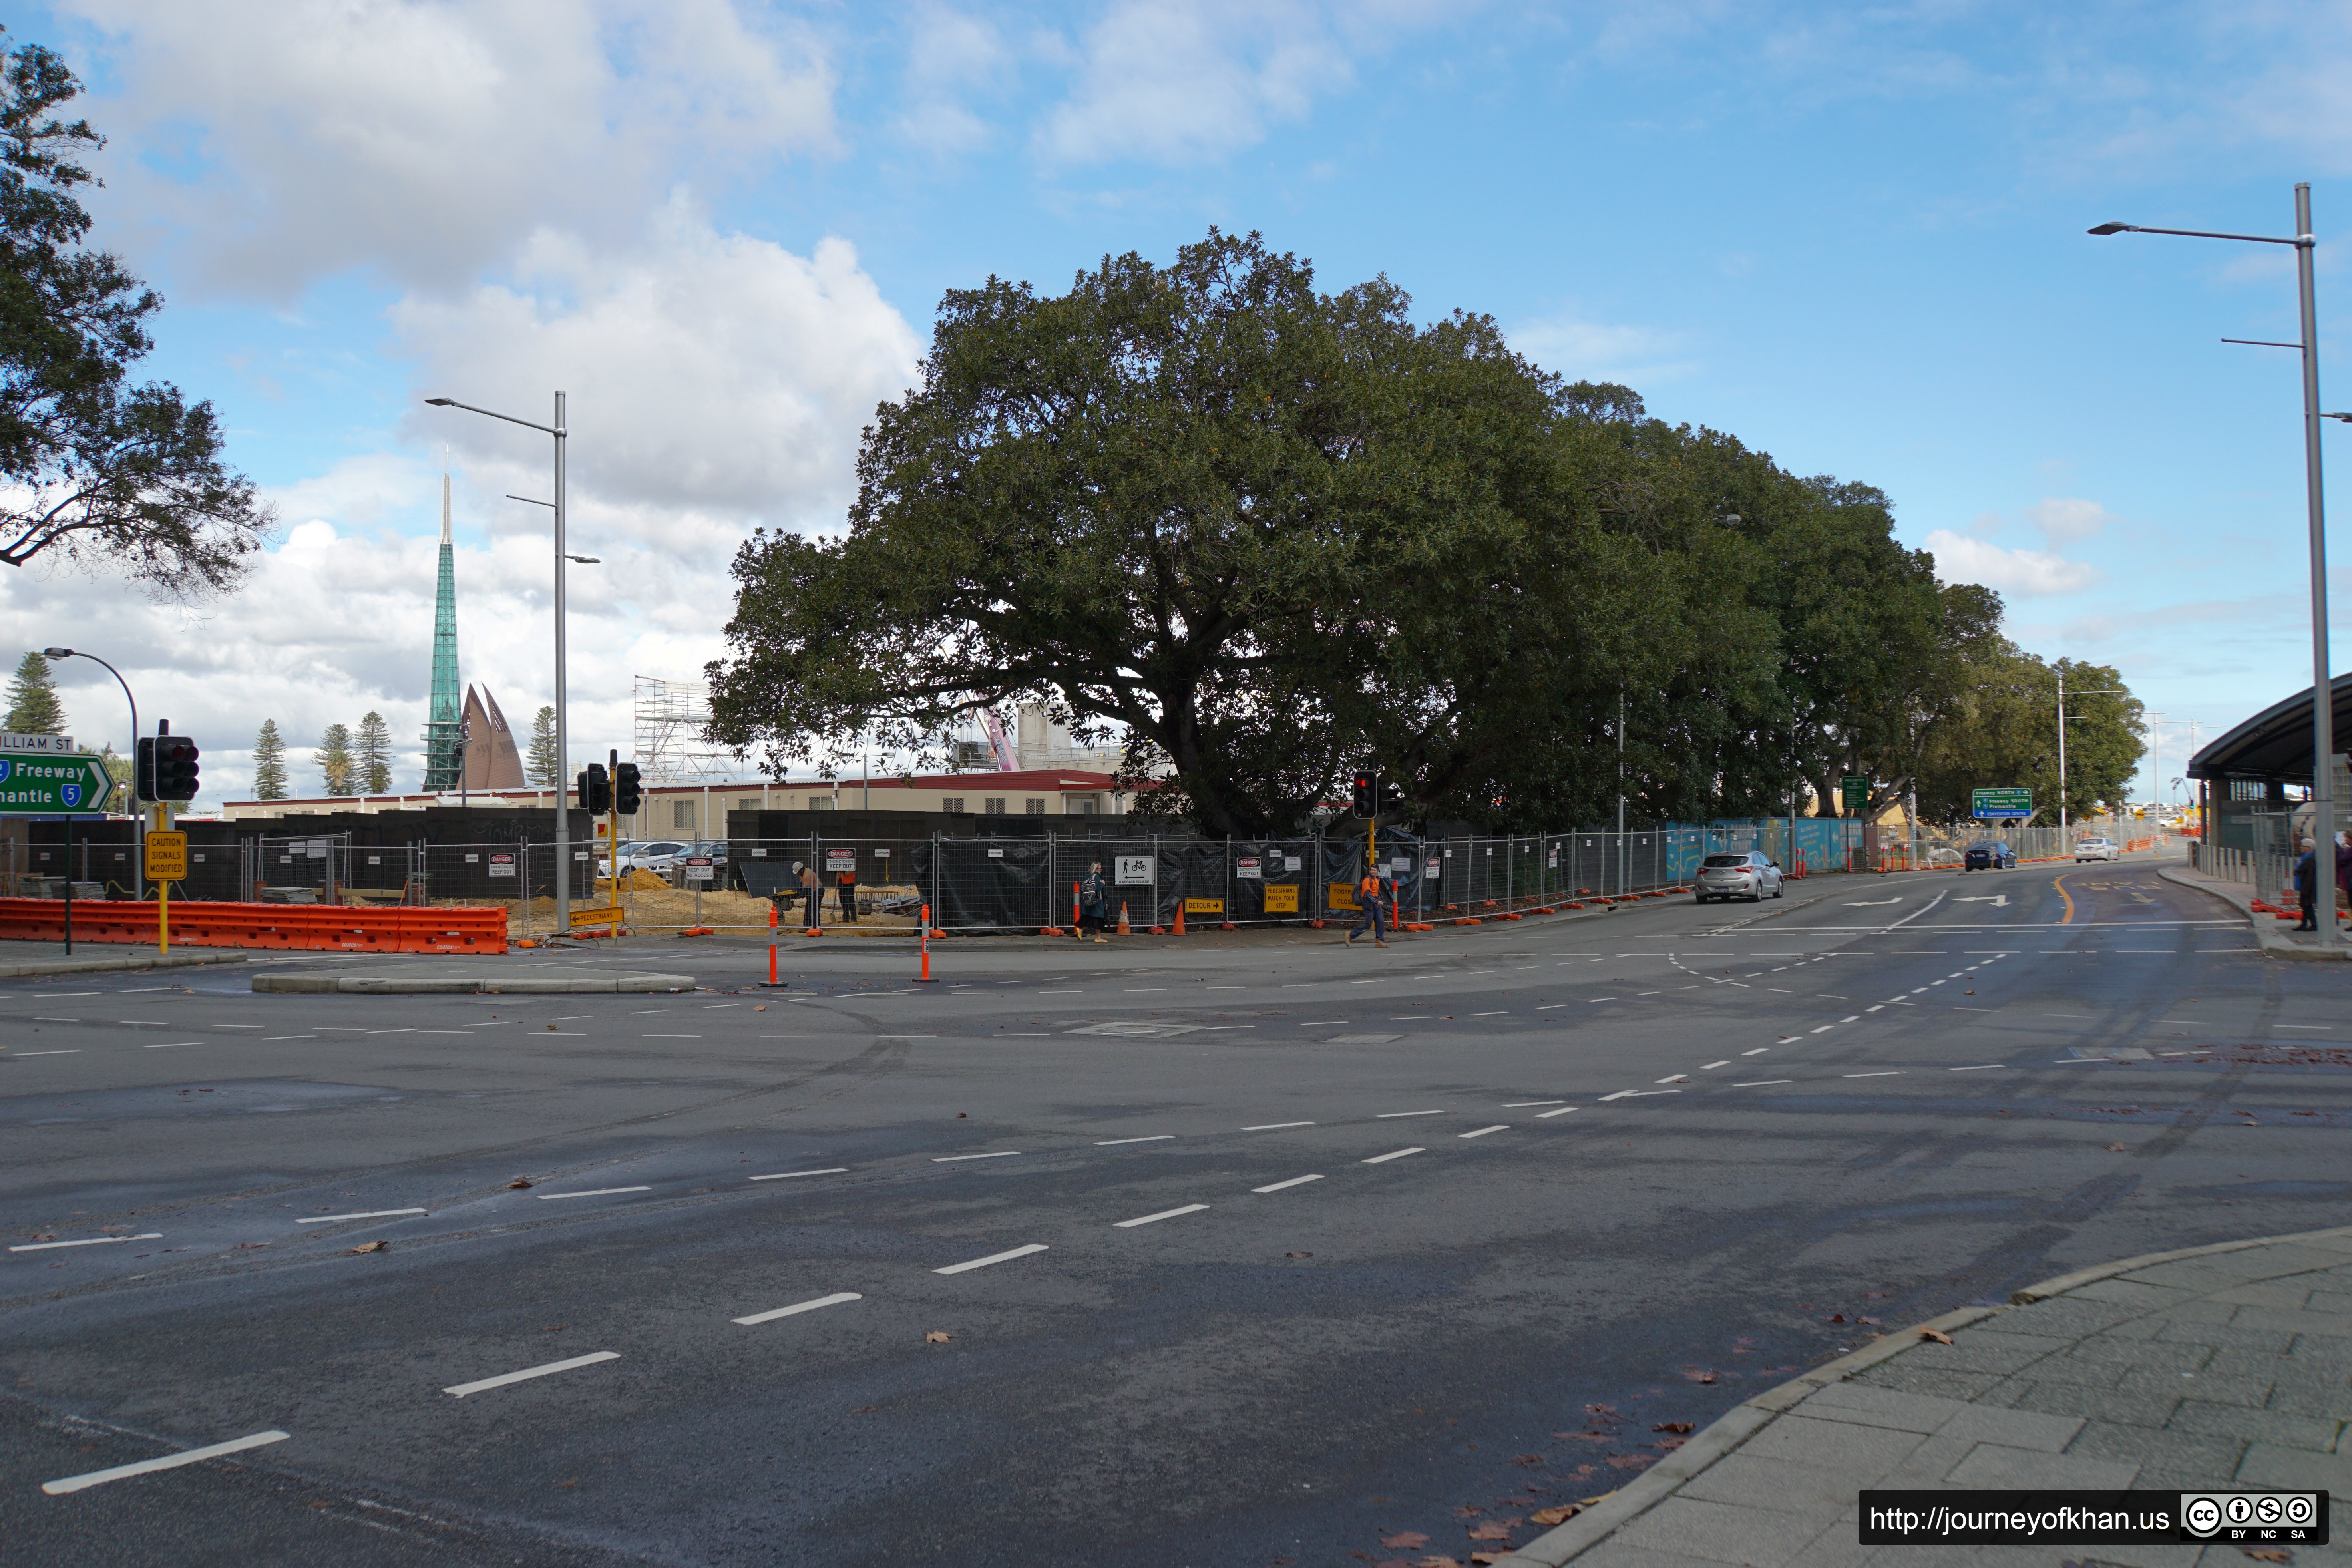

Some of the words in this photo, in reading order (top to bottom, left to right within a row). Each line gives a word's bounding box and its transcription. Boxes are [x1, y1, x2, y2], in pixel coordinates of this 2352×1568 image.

[56, 739, 71, 750] ST
[16, 763, 86, 782] Freeway
[68, 788, 75, 800] 5
[152, 838, 181, 846] CAUTION
[151, 851, 181, 860] SIGNALS
[150, 864, 182, 873] MODIFIED
[580, 912, 613, 921] PEDESTRIANS
